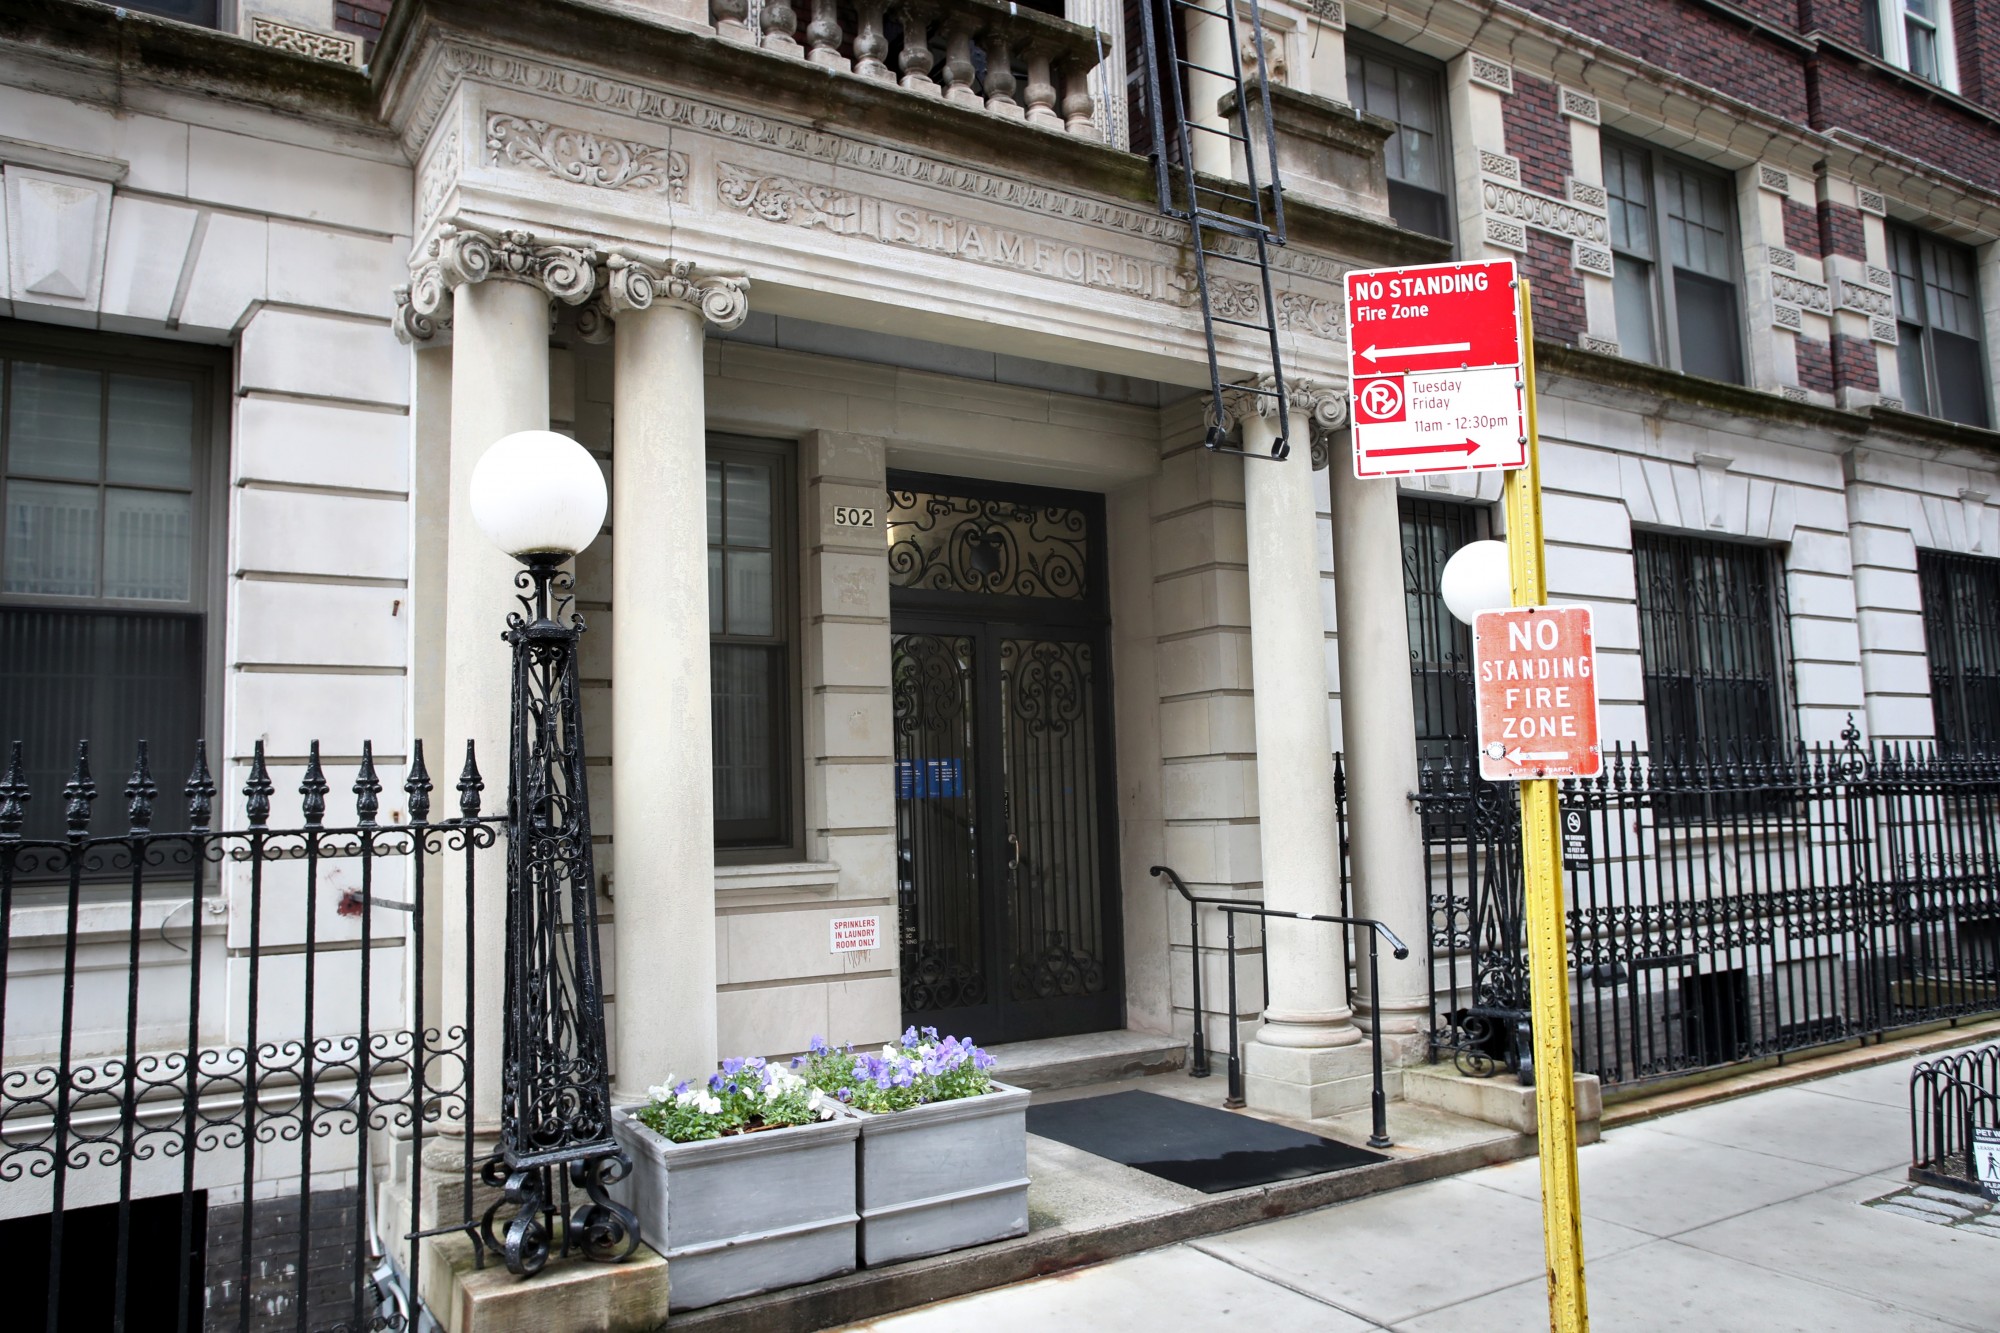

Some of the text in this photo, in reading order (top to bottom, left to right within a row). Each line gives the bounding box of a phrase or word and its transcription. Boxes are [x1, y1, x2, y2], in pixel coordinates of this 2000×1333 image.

[894, 208, 1144, 292] STAMFORD
[1355, 272, 1489, 301] NO STANDING
[1357, 303, 1429, 322] Fire Zone
[1412, 380, 1462, 394] Tuesday
[1412, 397, 1451, 411] Friday
[1415, 420, 1443, 433] 11am
[1455, 415, 1509, 431] 12:30pm
[836, 508, 873, 526] 502
[1508, 618, 1559, 652] NO
[1482, 656, 1591, 682] STANDING
[1506, 686, 1571, 710] FIRE
[1502, 715, 1577, 739] ZONE
[834, 919, 875, 930] SPRINKLERS
[845, 929, 875, 938] LAUNDRY
[836, 939, 875, 949] ROOM ONLY
[1976, 1129, 1992, 1137] PET
